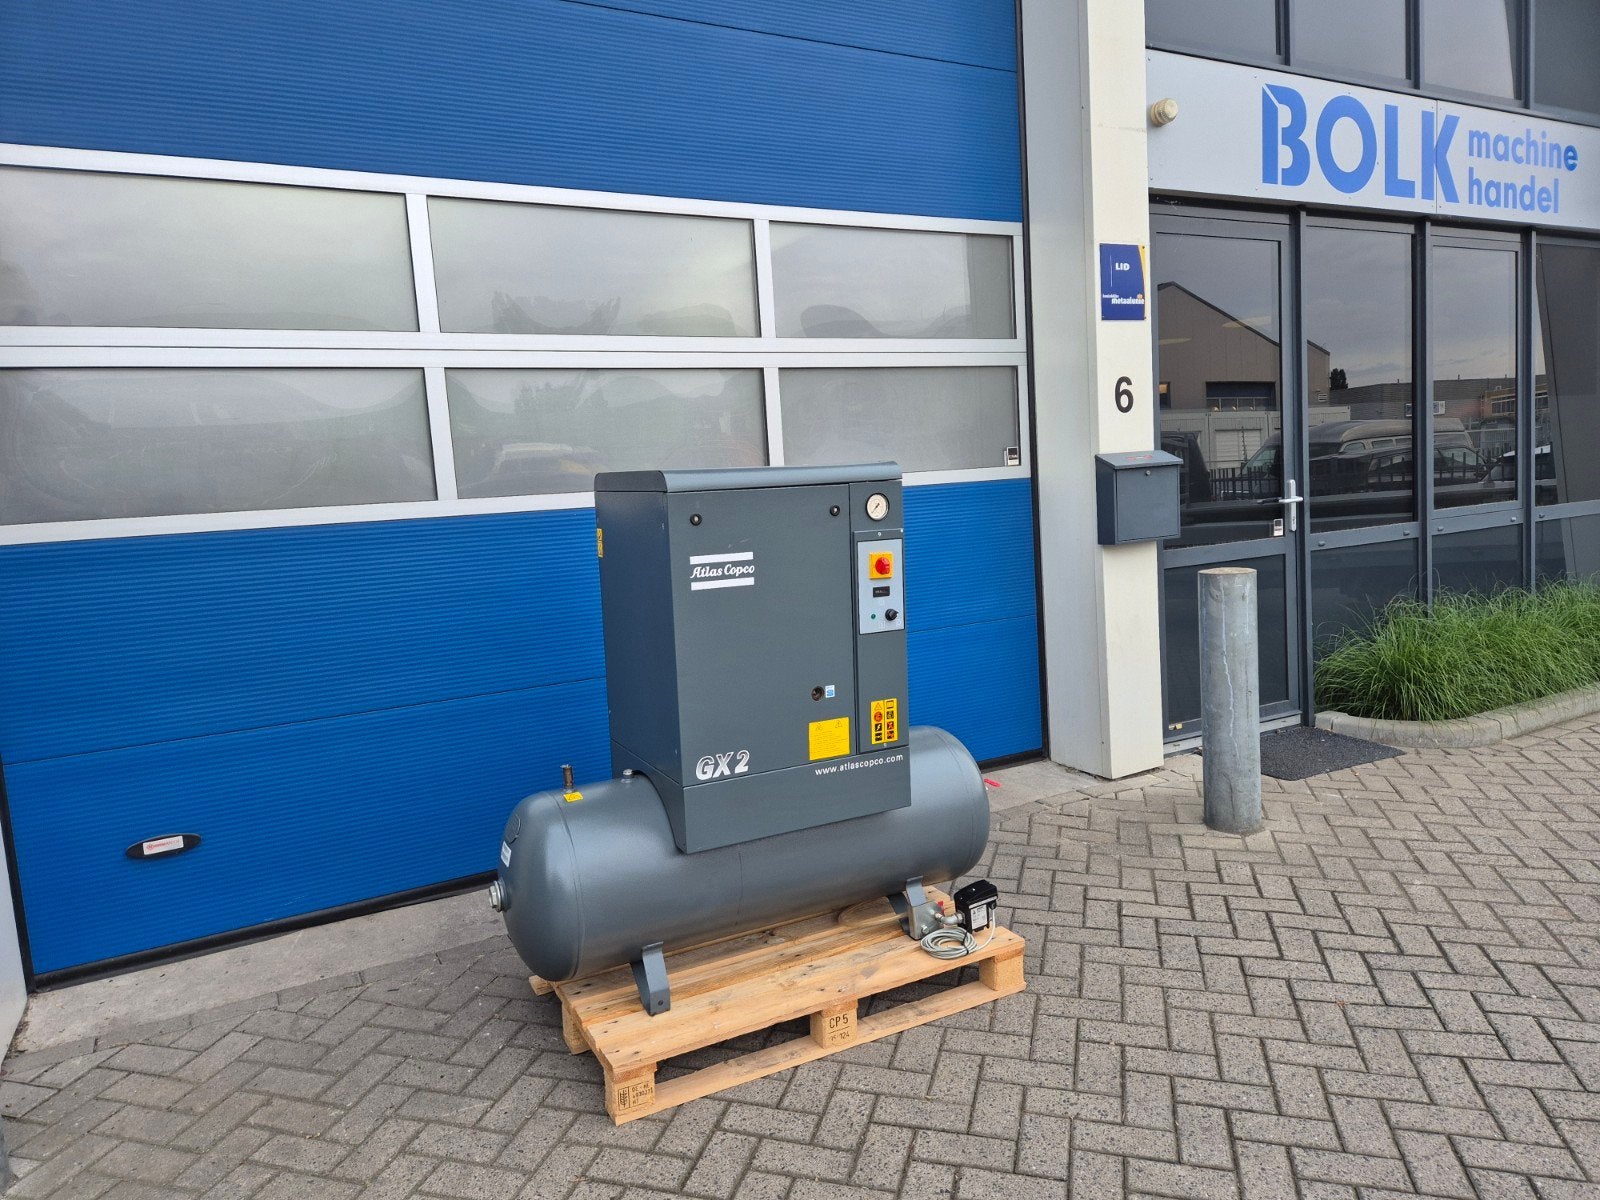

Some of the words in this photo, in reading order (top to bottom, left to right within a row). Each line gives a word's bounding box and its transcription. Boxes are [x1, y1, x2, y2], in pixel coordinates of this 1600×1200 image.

[1261, 83, 1461, 204] BOLK
[1468, 128, 1579, 172] machine
[1468, 166, 1560, 214] handel
[1115, 262, 1130, 271] LID
[1114, 376, 1134, 413] 6
[690, 566, 723, 578] Atlas
[723, 563, 755, 577] Copco
[814, 753, 904, 776] www.atlascopco.com
